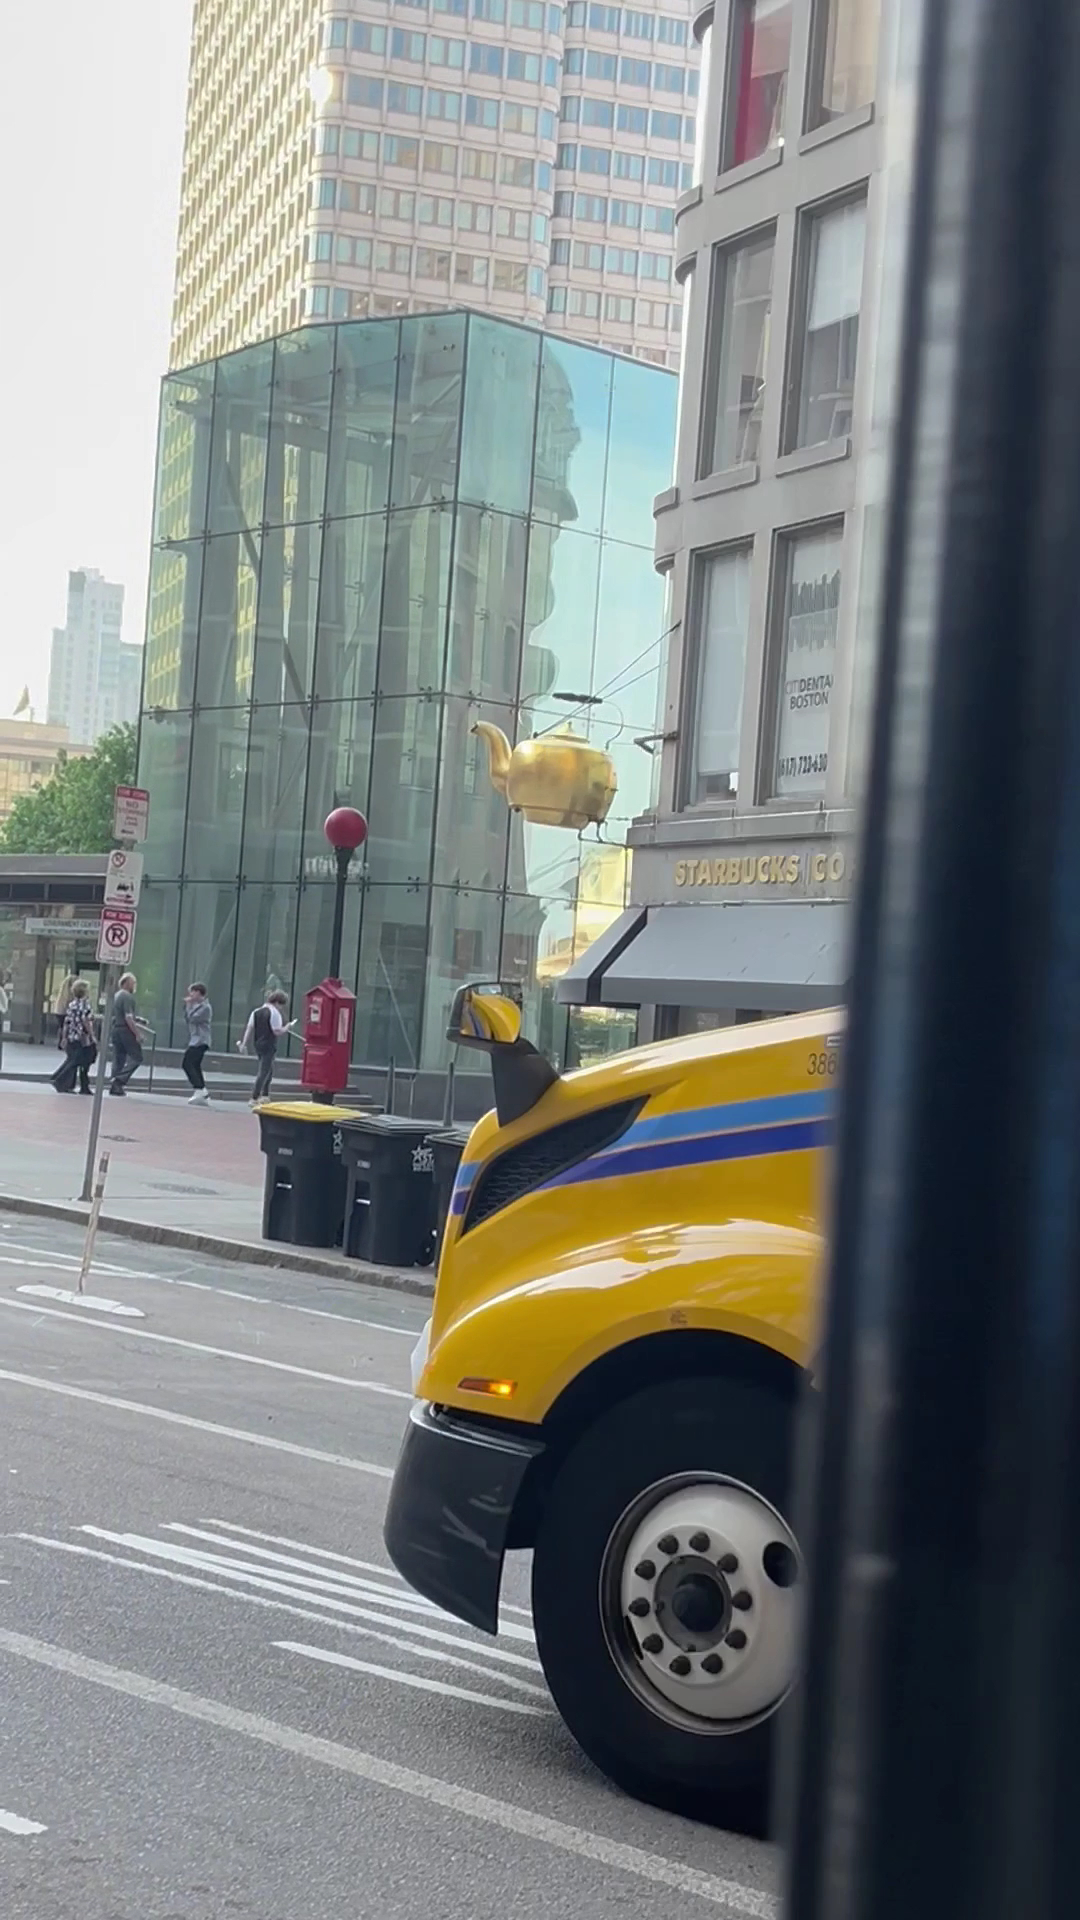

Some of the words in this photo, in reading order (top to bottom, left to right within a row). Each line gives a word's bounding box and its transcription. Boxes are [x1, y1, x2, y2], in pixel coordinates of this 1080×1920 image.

[789, 692, 829, 710] BOSTON
[674, 855, 801, 887] STARBUCKS
[812, 851, 855, 882] CO
[807, 1053, 837, 1075] 386
